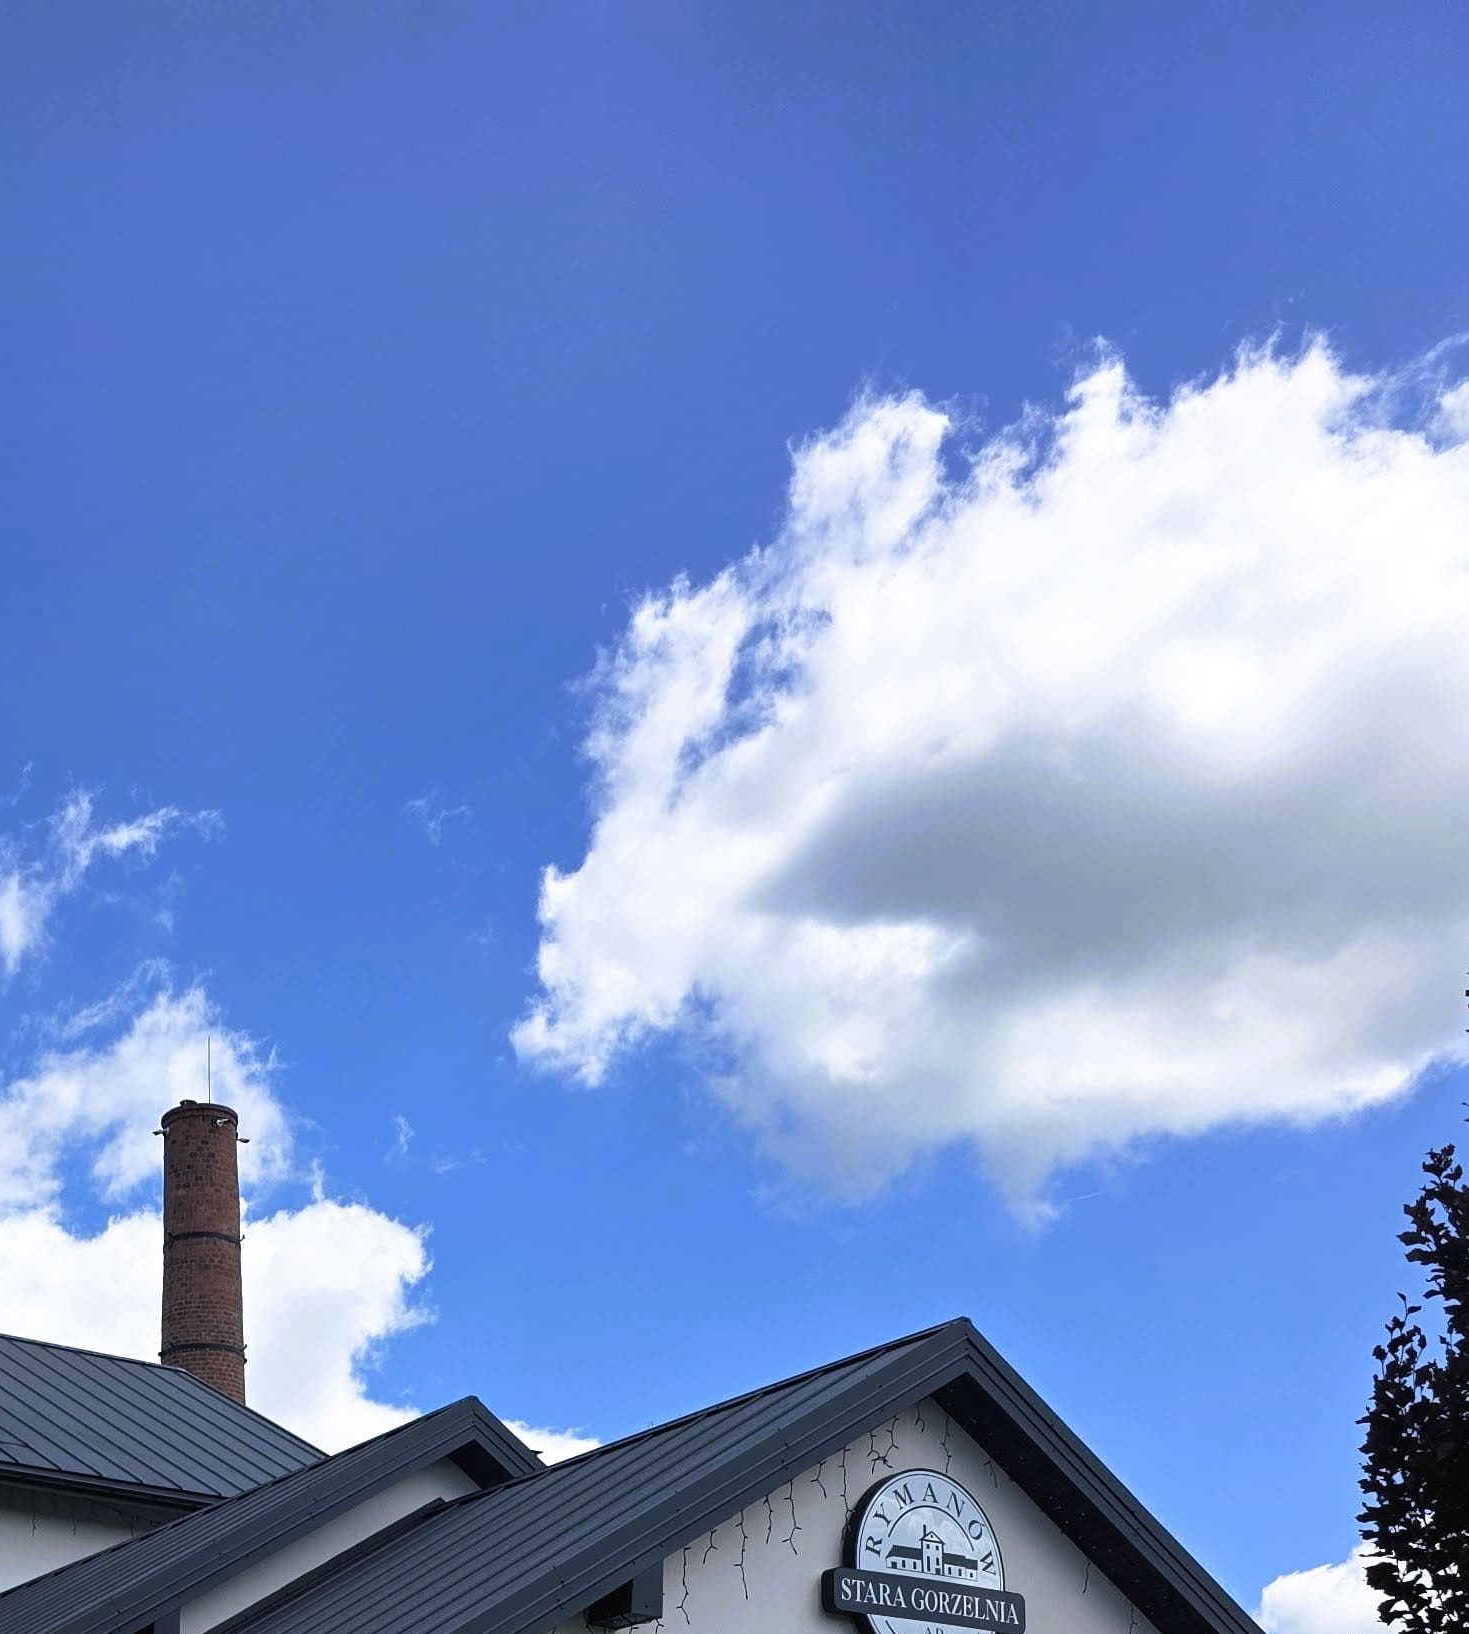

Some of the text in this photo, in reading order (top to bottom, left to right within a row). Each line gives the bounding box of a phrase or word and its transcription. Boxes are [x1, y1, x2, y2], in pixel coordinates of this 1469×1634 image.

[865, 1481, 997, 1576] RYMANÓW
[840, 1577, 1020, 1625] STARA GORZELNIA
